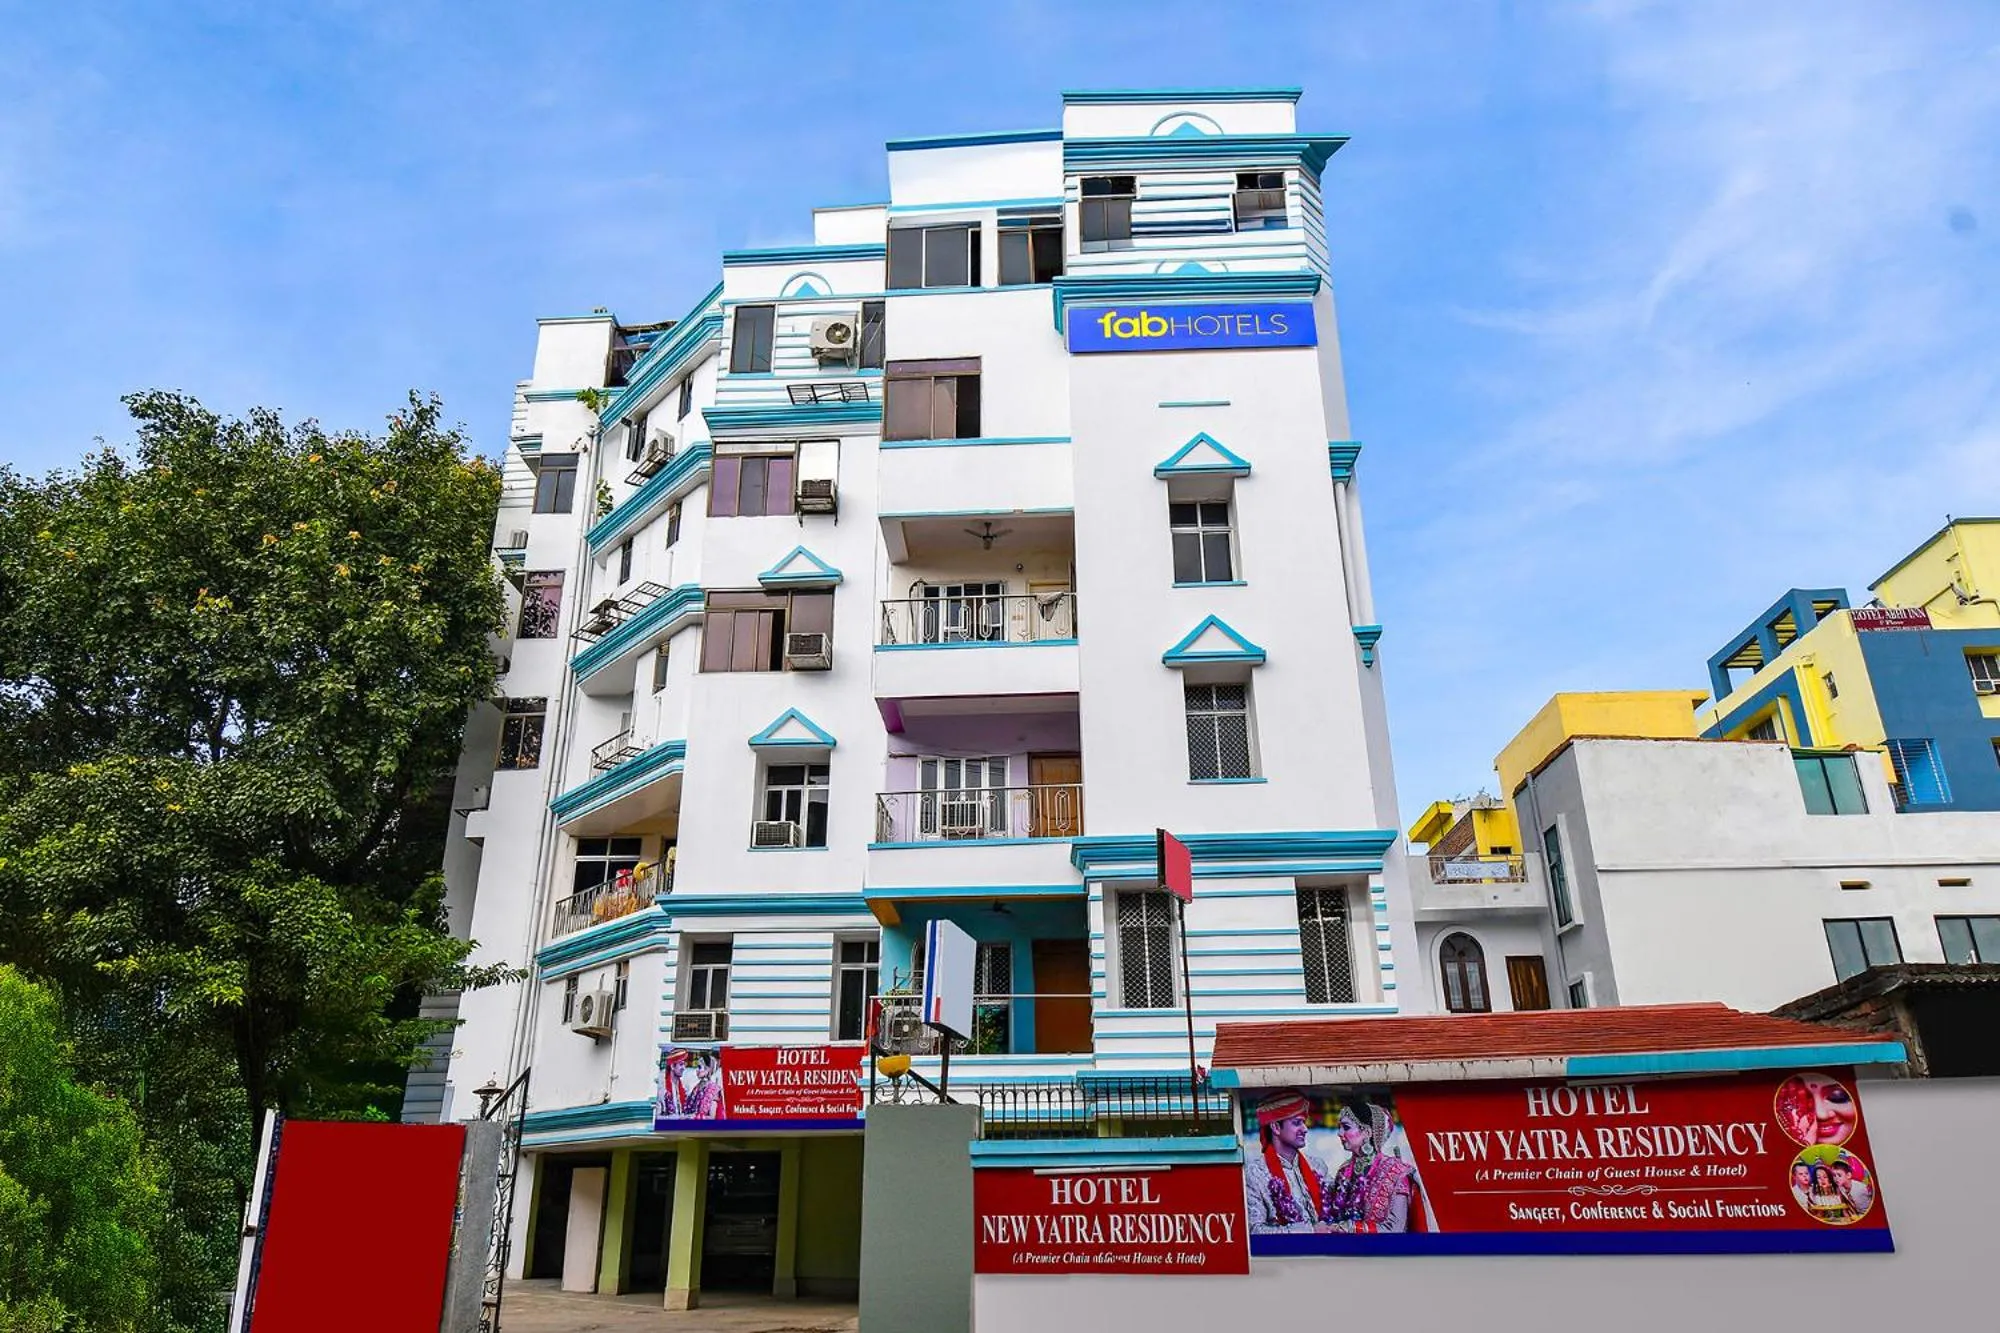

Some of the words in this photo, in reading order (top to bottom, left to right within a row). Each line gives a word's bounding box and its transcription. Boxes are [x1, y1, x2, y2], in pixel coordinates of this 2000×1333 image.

[1851, 608, 1885, 621] HOTEL
[1908, 607, 1927, 619] INN
[776, 1049, 830, 1065] HOTEL
[728, 1069, 758, 1086] NEW
[760, 1069, 801, 1086] YATRA
[796, 1088, 802, 1096] of
[1524, 1084, 1649, 1118] HOTEL
[819, 1104, 825, 1114] &
[1426, 1130, 1490, 1162] NEW
[1495, 1128, 1593, 1161] YATRA
[1595, 1122, 1768, 1160] RESIDENCY
[1475, 1169, 1490, 1183] (A
[1493, 1168, 1542, 1180] Premier
[1545, 1167, 1583, 1180] Chain
[1587, 1167, 1601, 1181] of
[1604, 1166, 1641, 1178] Guest
[1644, 1165, 1686, 1178] House
[1690, 1165, 1702, 1177] &
[1706, 1164, 1748, 1177] Hotel)
[1050, 1177, 1161, 1205] HOTEL
[1652, 1200, 1664, 1219] &
[981, 1214, 1031, 1244] NEW
[1034, 1214, 1104, 1244] YATRA
[1108, 1213, 1236, 1244] RESIDENCY
[1012, 1252, 1023, 1266] (A
[1025, 1252, 1061, 1264] Premier
[1062, 1252, 1090, 1264] Chain
[1132, 1252, 1162, 1264] House
[1165, 1252, 1173, 1264] &
[1176, 1252, 1206, 1266] Hotel)
